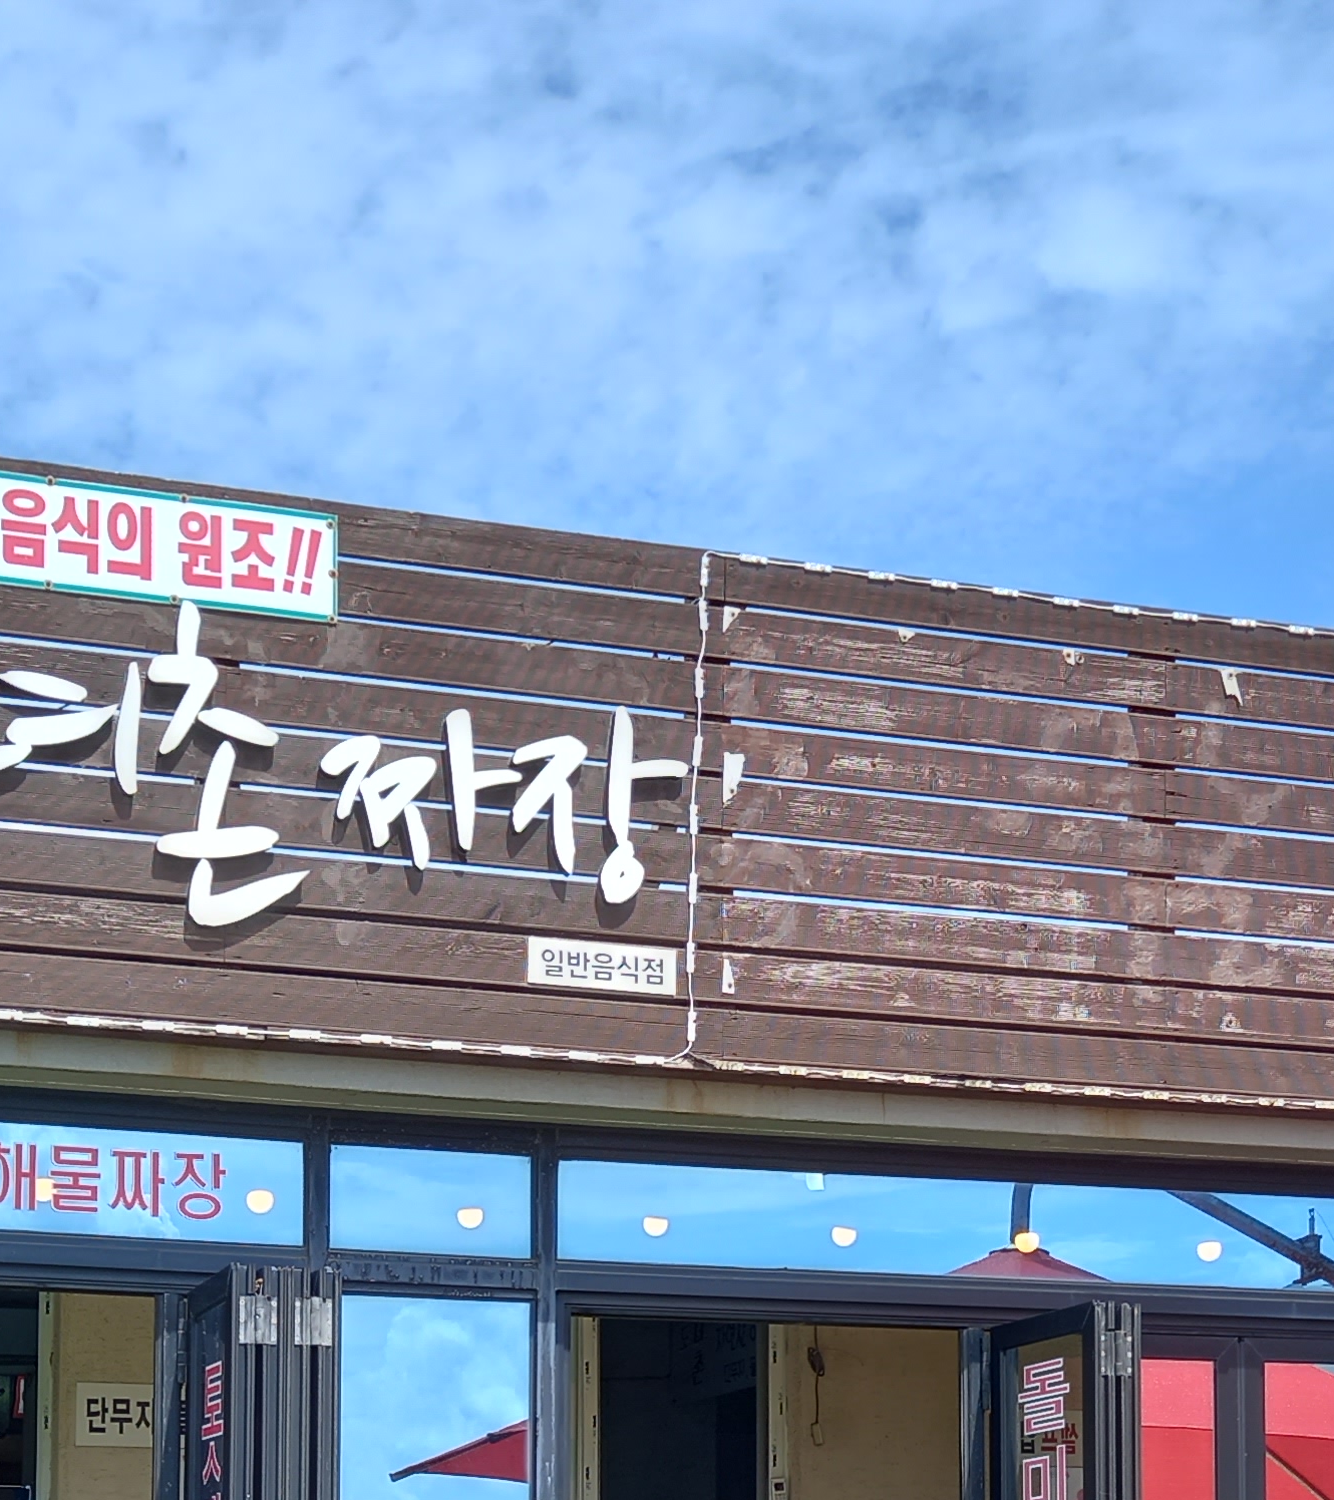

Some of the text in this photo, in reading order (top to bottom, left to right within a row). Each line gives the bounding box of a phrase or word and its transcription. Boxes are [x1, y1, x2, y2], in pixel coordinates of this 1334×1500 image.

[0, 486, 154, 582] 음식의
[177, 508, 322, 598] 원조!!
[539, 946, 667, 988] 일반음식점
